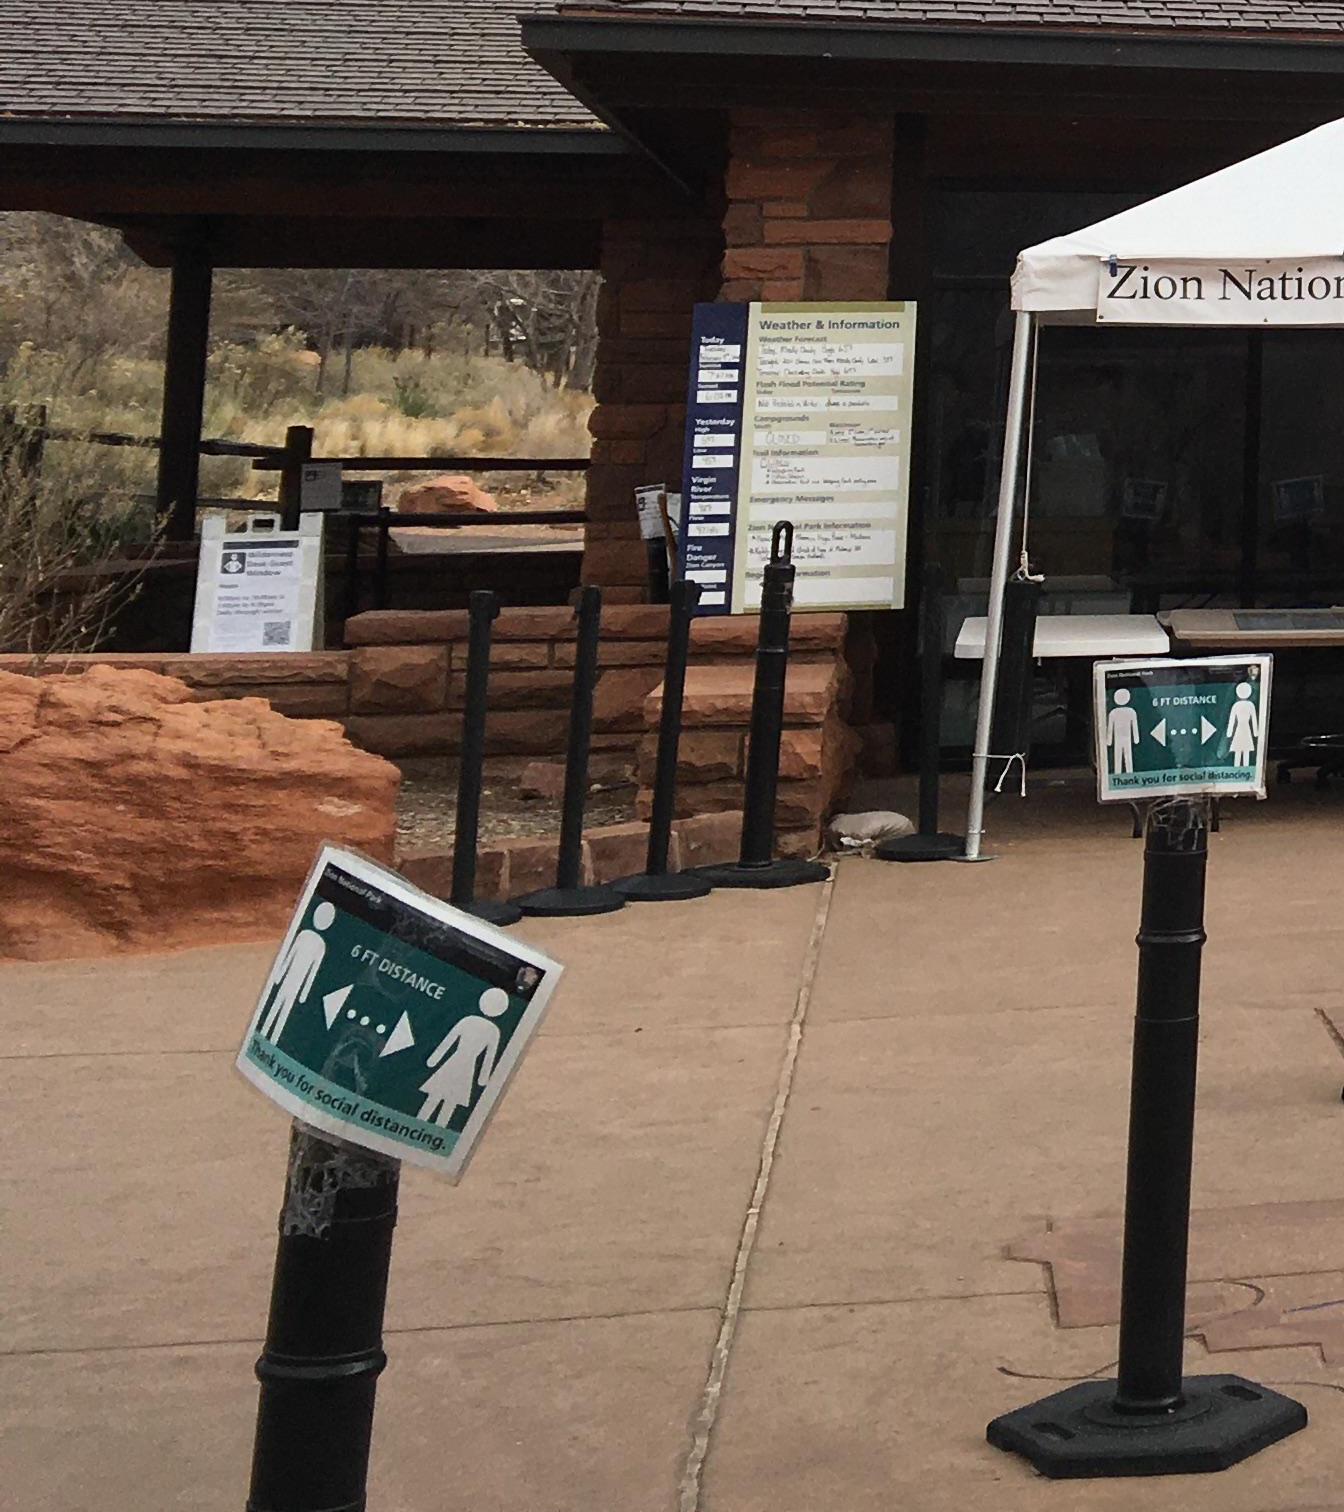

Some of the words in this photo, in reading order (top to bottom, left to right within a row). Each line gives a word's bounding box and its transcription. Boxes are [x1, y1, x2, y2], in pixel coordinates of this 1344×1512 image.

[1107, 265, 1205, 300] Zion
[759, 319, 812, 330] Weather
[815, 320, 825, 330] &
[828, 319, 900, 330] Information
[700, 336, 725, 345] Today
[758, 335, 794, 343] Weather
[795, 335, 828, 343] Forecast
[756, 380, 777, 388] Flash
[802, 380, 838, 388] Potential
[840, 379, 866, 388] Rating
[695, 418, 735, 427] Yesterday
[754, 414, 810, 423] Campgrounds
[771, 449, 819, 457] Information
[691, 476, 717, 485] Virgin
[690, 485, 712, 493] River
[749, 496, 793, 504] Emergency
[796, 495, 835, 503] Messages
[804, 522, 822, 530] Park
[824, 521, 872, 530] Information
[687, 544, 702, 552] Fire
[686, 553, 717, 562] Danger
[1152, 698, 1159, 707] 6
[1160, 697, 1171, 707] FT
[1172, 694, 1217, 706] DISTANCE
[1112, 777, 1139, 786] Thank
[1141, 776, 1160, 786] you
[1162, 773, 1177, 783] for
[1179, 770, 1207, 782] social
[1207, 769, 1253, 782] distancing.
[365, 890, 383, 904] Park
[350, 944, 361, 959] 6
[360, 949, 379, 968] FT
[378, 957, 447, 1001] DISTANCE
[251, 1039, 277, 1070] Thank
[273, 1059, 295, 1085] you
[294, 1073, 315, 1095] for
[314, 1084, 359, 1117] social
[359, 1105, 447, 1152] distancing.
